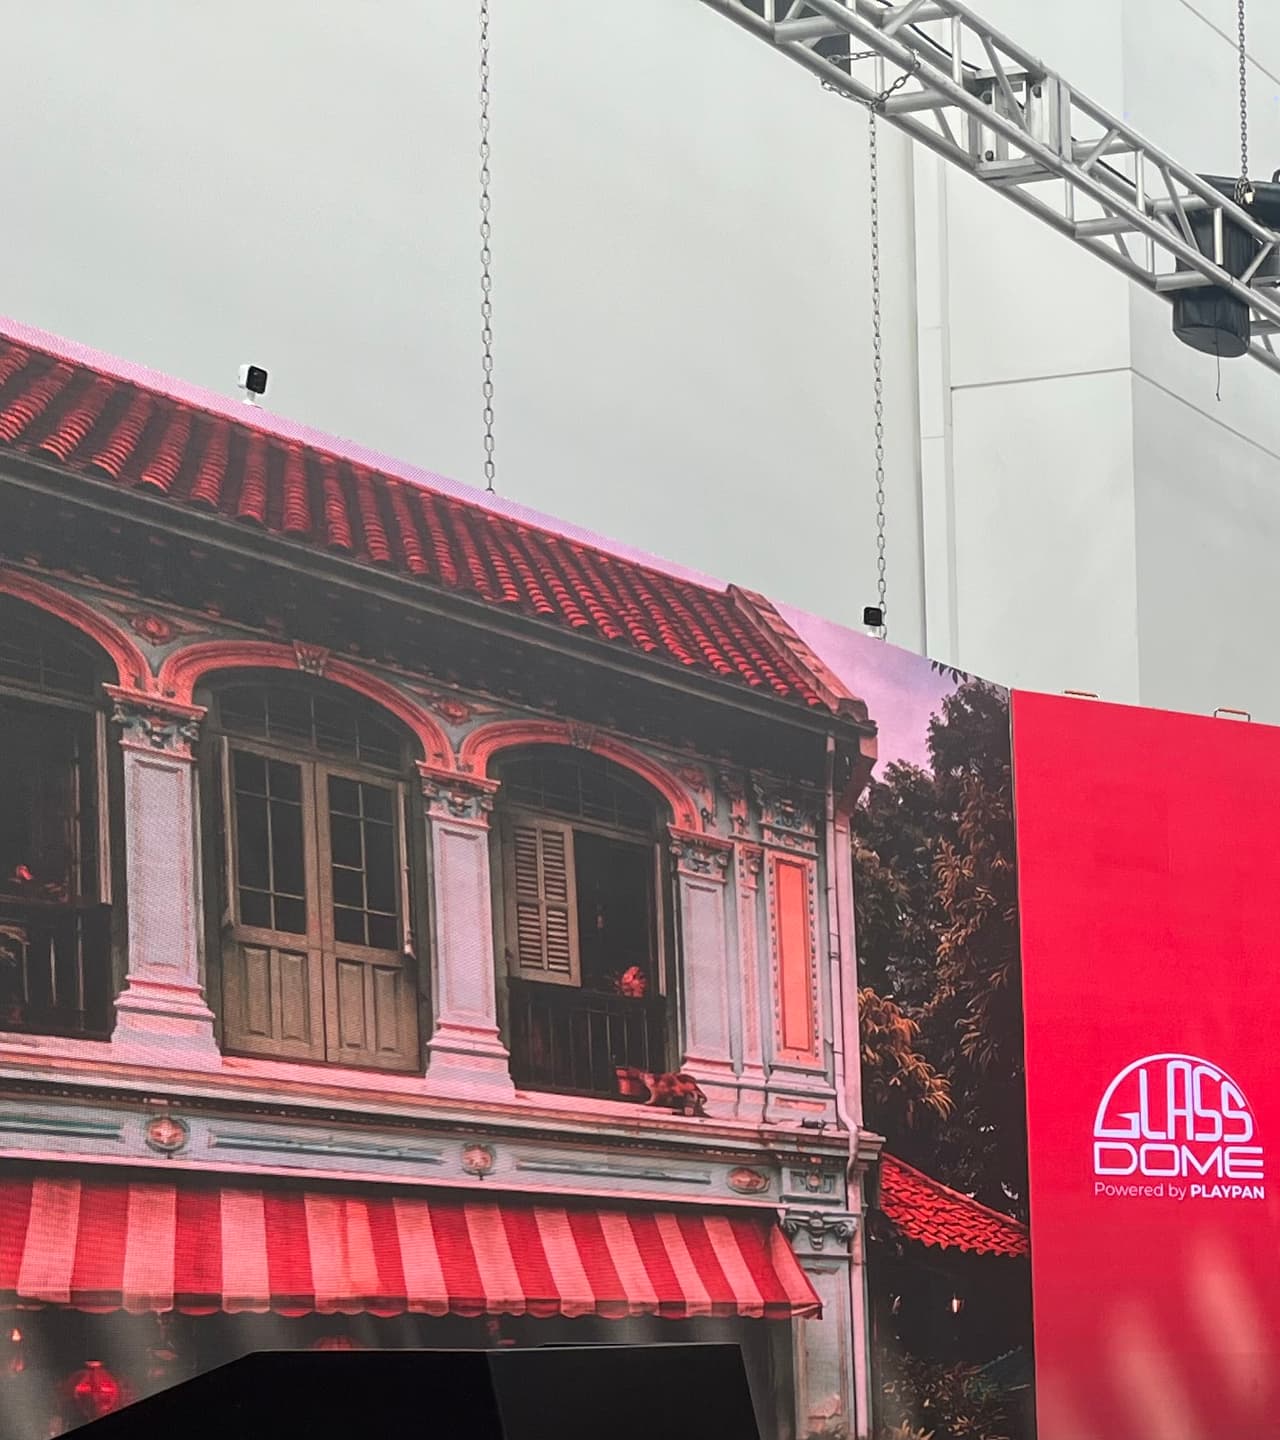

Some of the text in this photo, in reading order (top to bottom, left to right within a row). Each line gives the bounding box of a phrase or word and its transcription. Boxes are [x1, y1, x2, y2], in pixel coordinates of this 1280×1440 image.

[1093, 1053, 1255, 1143] GLASS
[1094, 1141, 1264, 1179] DOME
[1095, 1182, 1265, 1200] Powered by PLAYPAN
